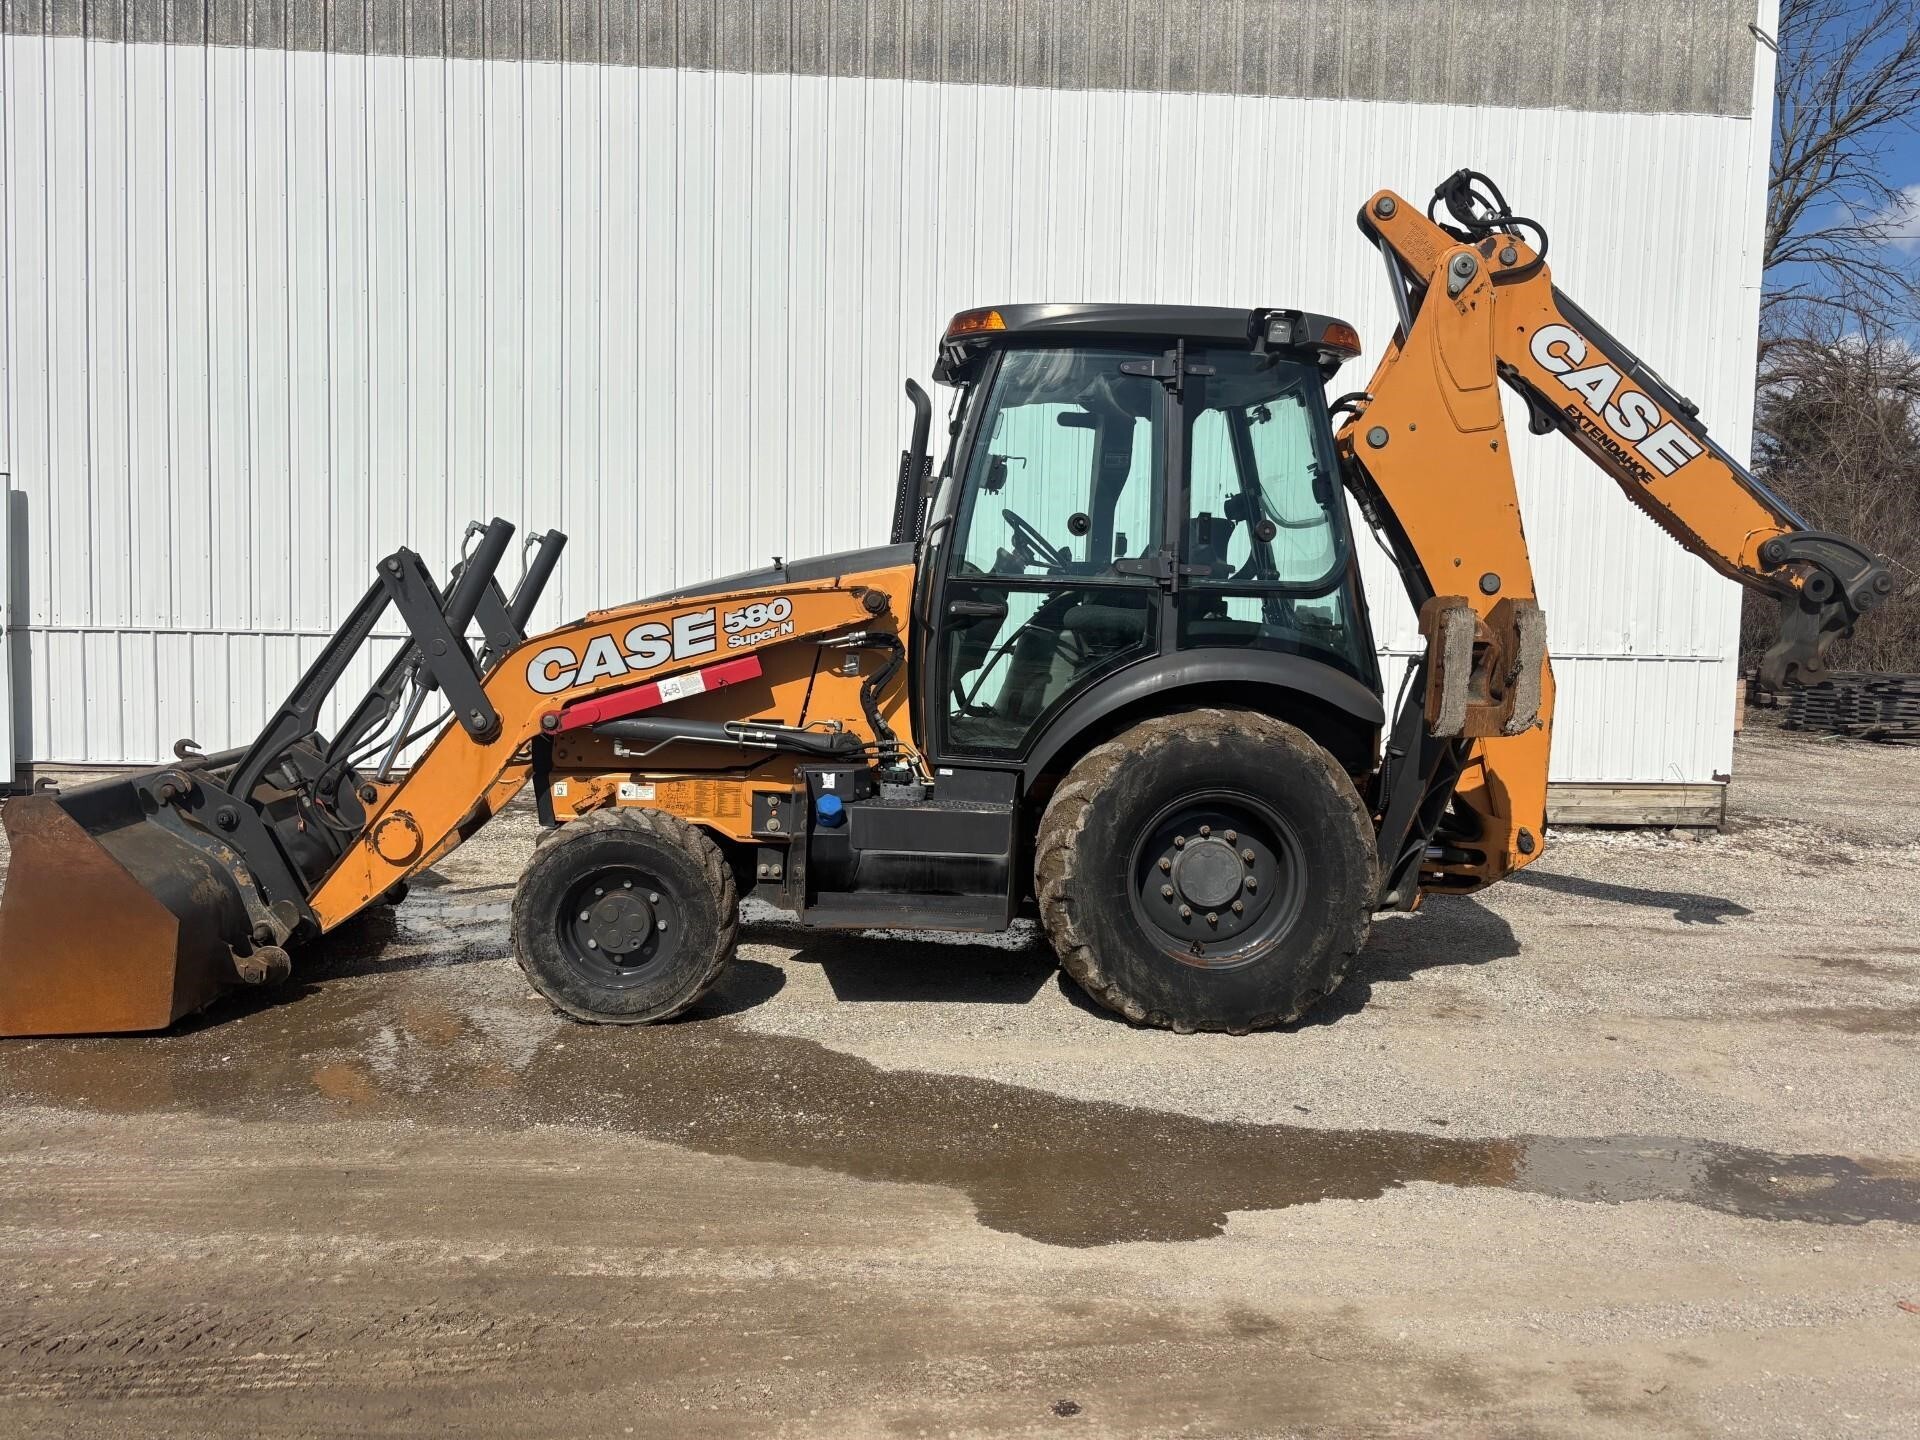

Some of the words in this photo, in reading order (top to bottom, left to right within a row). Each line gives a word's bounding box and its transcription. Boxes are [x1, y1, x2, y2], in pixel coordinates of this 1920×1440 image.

[1529, 323, 1705, 477] CASE
[1563, 404, 1656, 485] EXTENDAHOE
[526, 607, 717, 694] CASE
[723, 597, 793, 634] 580
[727, 627, 780, 648] Super
[780, 620, 795, 636] N
